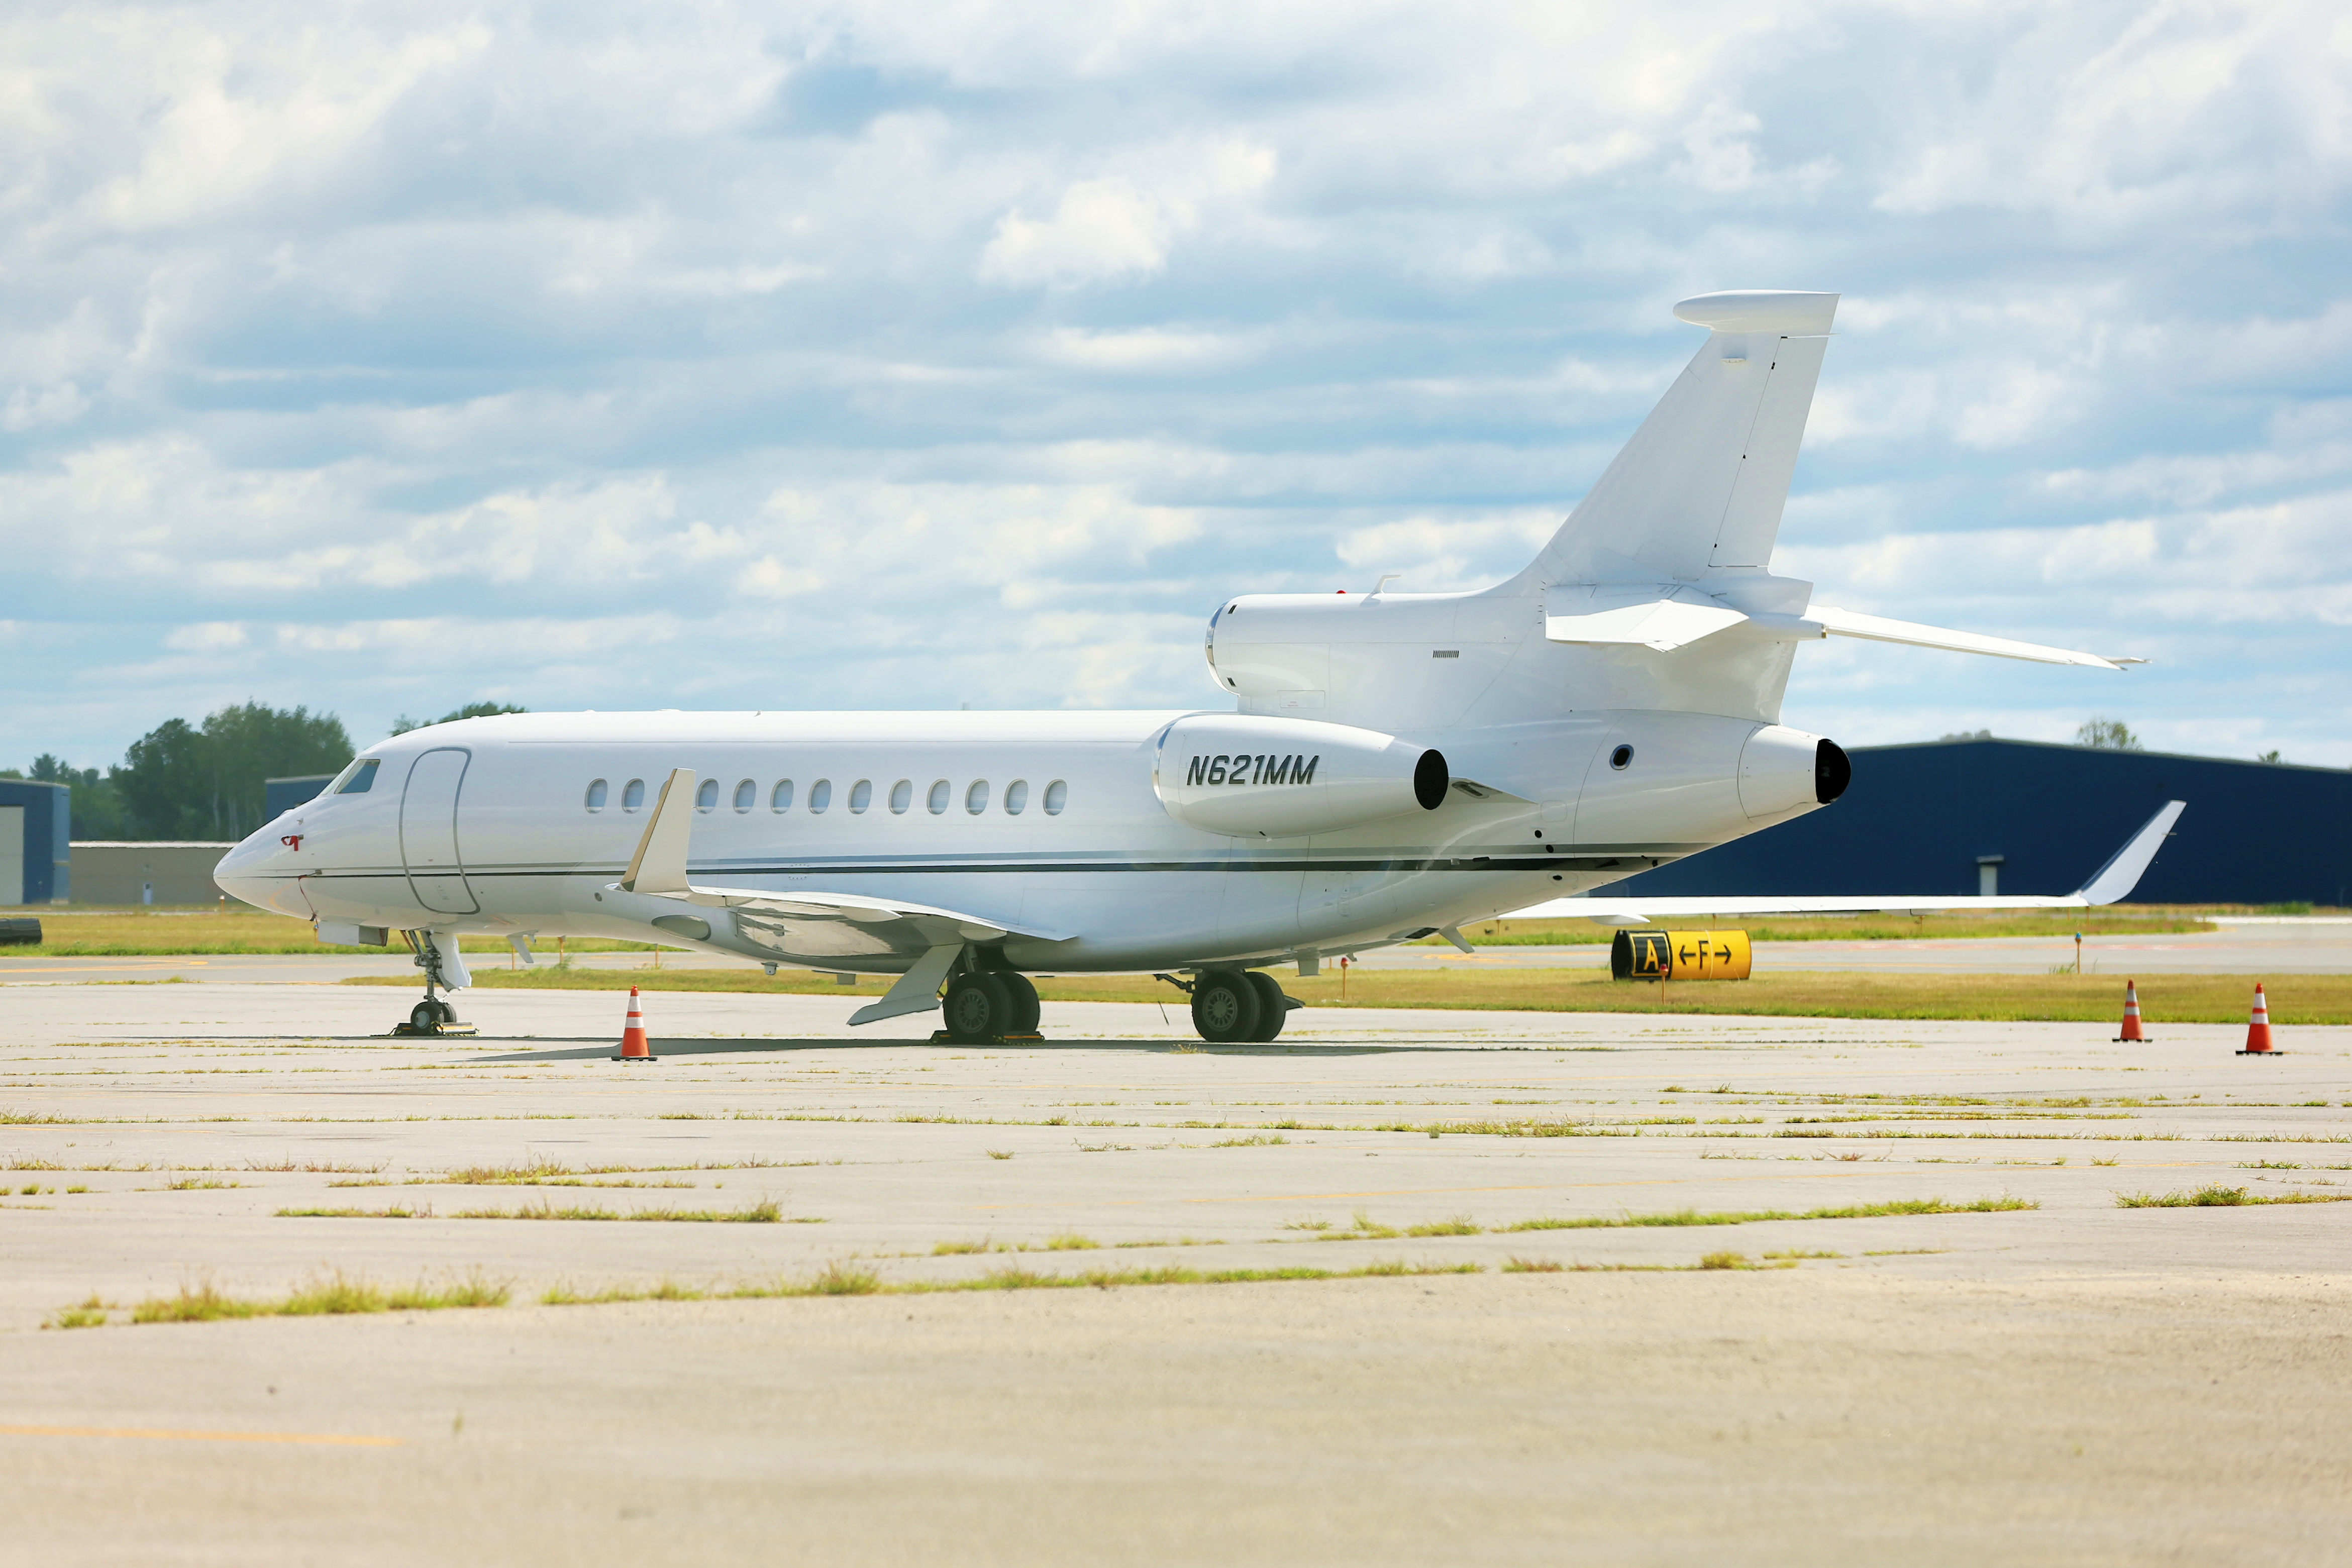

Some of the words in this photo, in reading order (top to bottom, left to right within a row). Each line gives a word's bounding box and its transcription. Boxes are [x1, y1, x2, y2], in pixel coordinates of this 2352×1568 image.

[1186, 755, 1319, 785] N621MM
[1644, 938, 1659, 971] A
[1698, 940, 1709, 970] F
